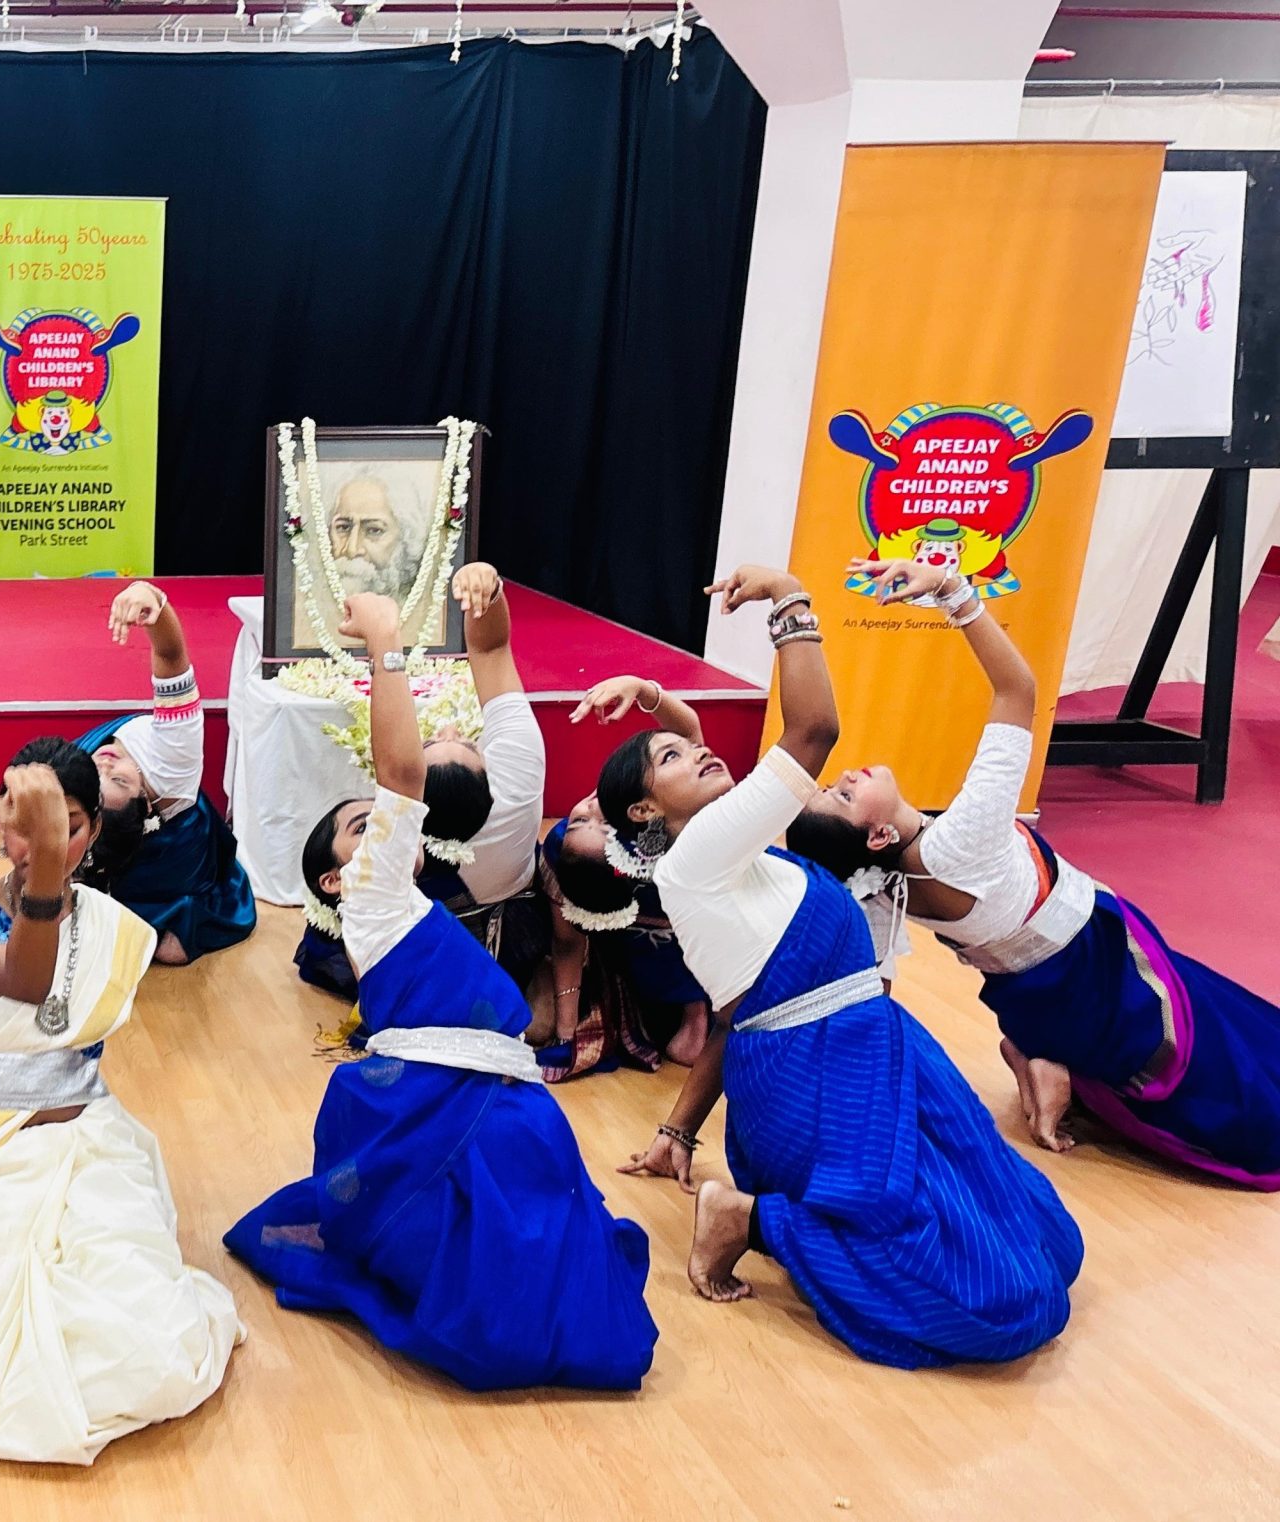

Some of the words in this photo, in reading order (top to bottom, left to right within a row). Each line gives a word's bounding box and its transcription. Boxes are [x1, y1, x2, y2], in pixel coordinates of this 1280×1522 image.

[8, 263, 106, 281] 1975-2025
[29, 333, 84, 344] APEEJAY
[33, 347, 80, 358] ANAND
[18, 362, 94, 373] CHILDREN'S
[28, 376, 84, 388] LIBRARY
[913, 439, 1000, 454] APEEJAY
[917, 459, 989, 474] ANAND
[61, 483, 112, 495] ANAND
[890, 479, 1009, 494] CHILDREN'S
[69, 500, 126, 512] LIBRARY
[902, 499, 990, 514] LIBRARY
[58, 518, 115, 529] SCHOOL
[20, 534, 47, 547] Park
[50, 534, 88, 546] Street
[843, 619, 857, 627] An
[859, 619, 902, 630] Apeejay
